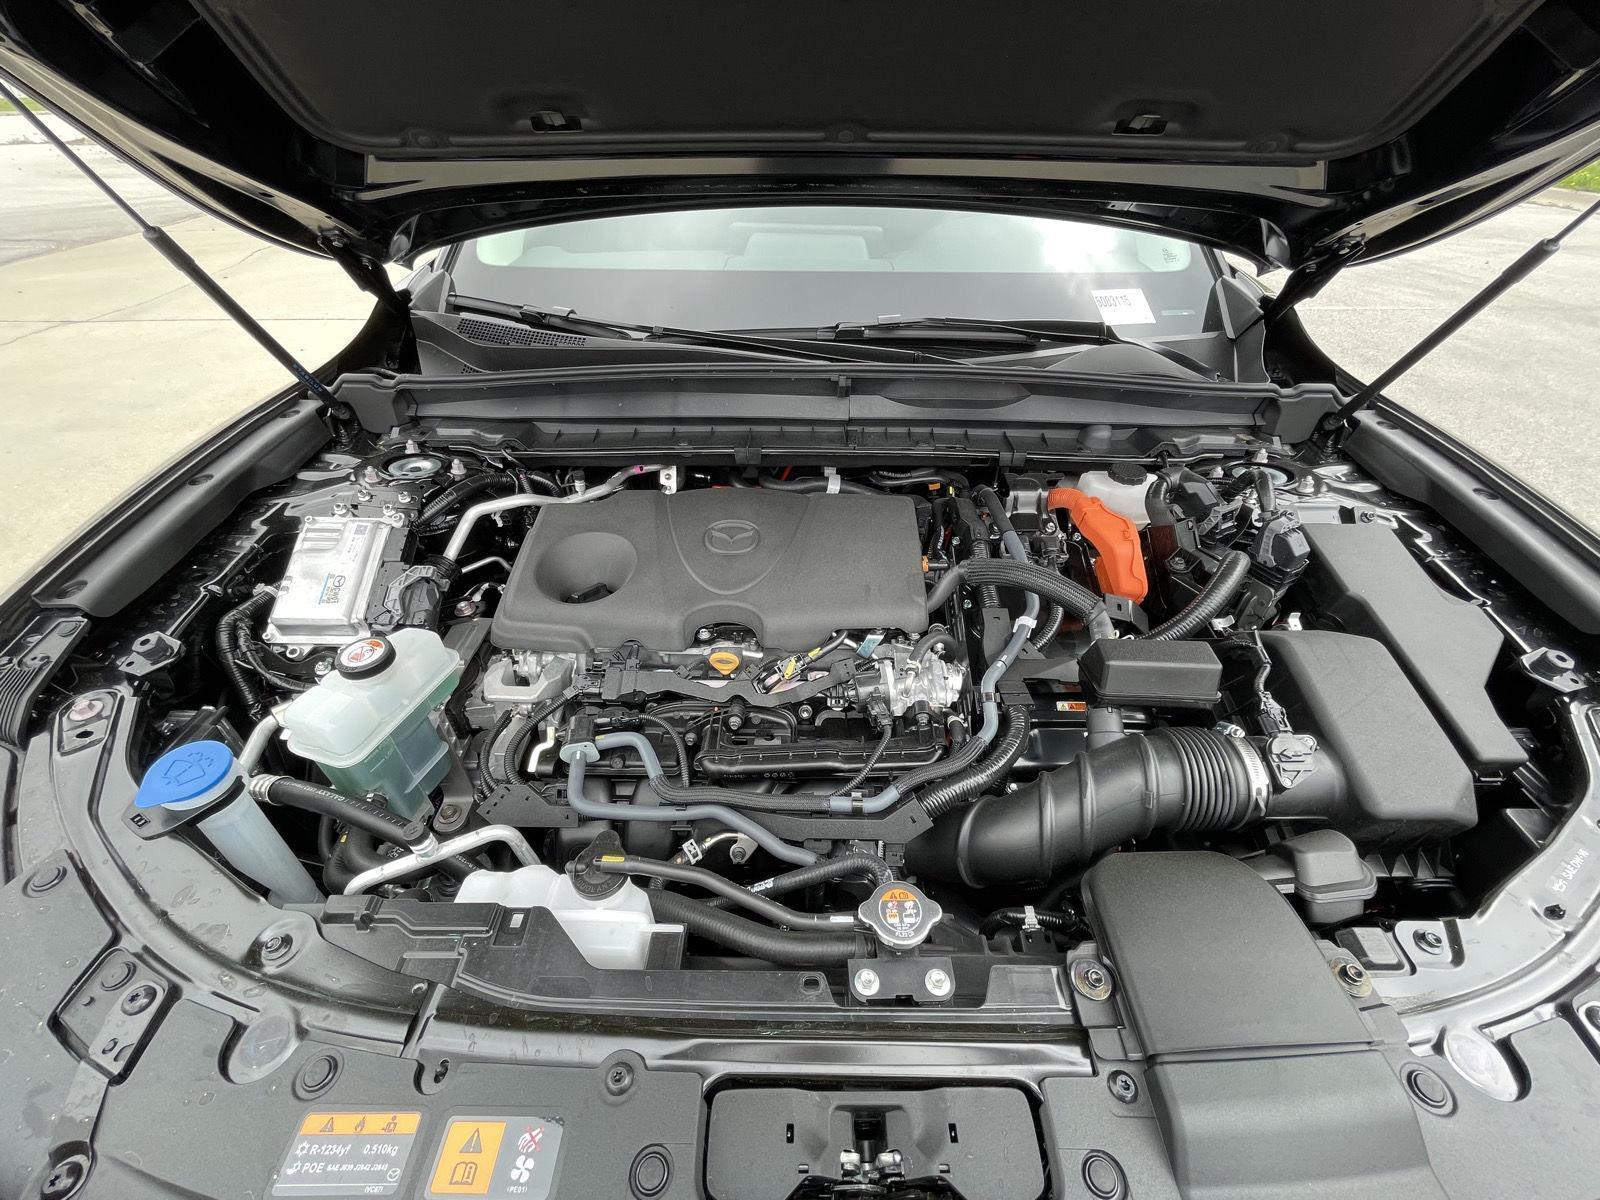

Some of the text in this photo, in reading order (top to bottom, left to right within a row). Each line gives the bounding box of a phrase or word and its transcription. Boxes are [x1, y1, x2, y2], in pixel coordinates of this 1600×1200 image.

[309, 1144, 399, 1157] R-1234yf 0.510kg
[301, 1162, 325, 1174] POE
